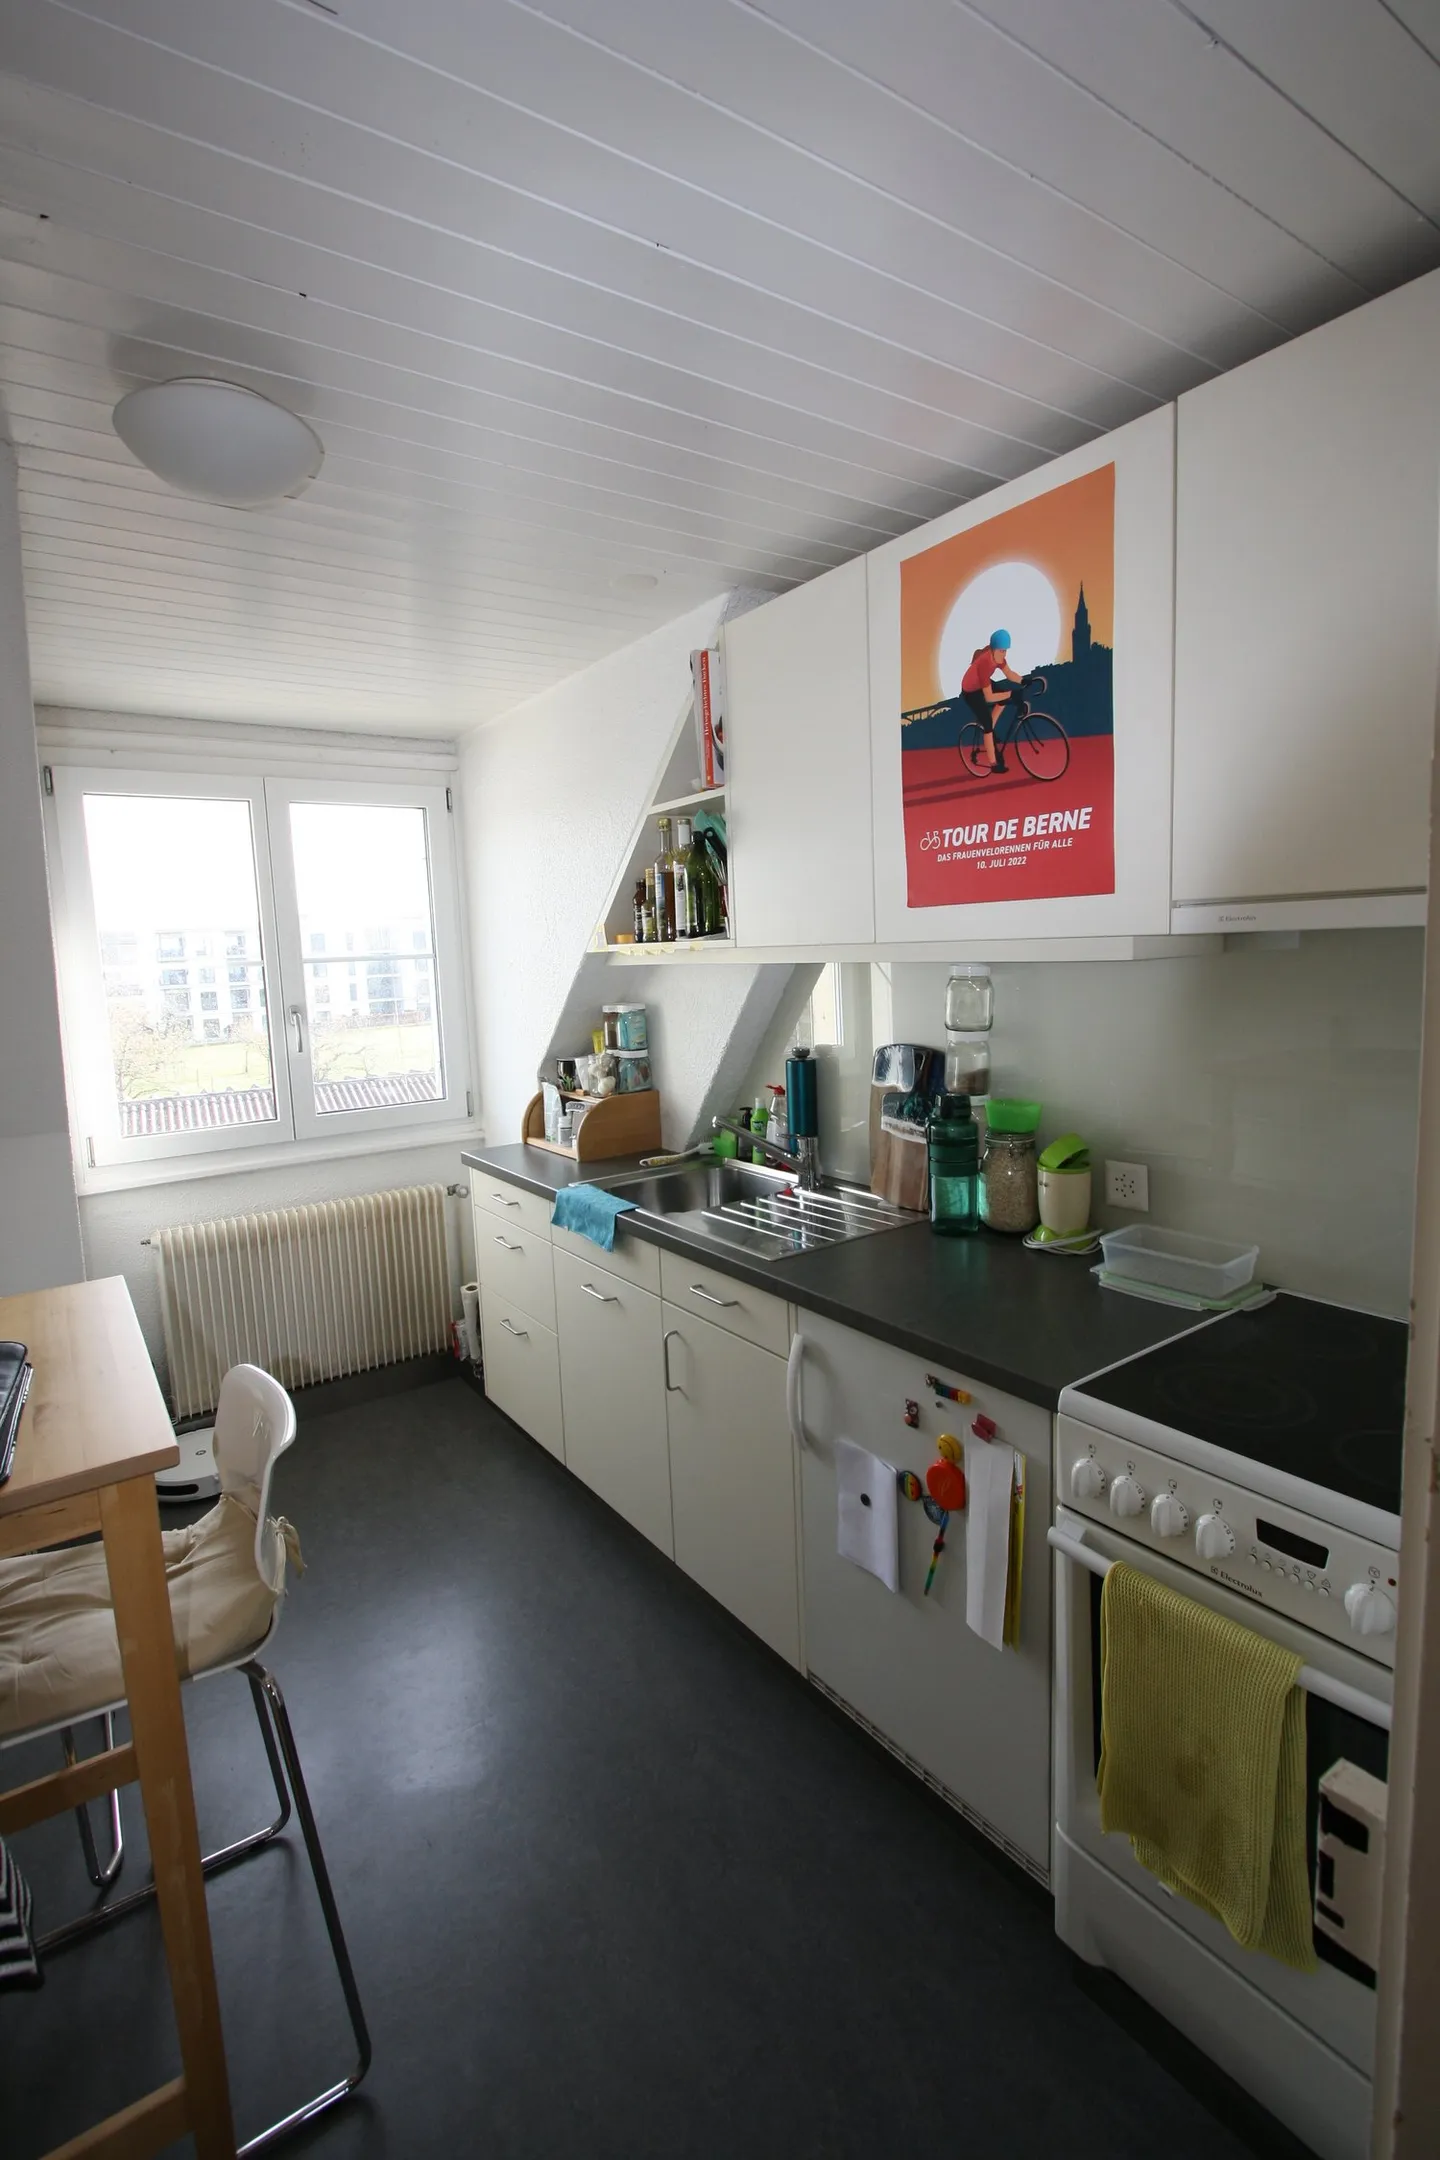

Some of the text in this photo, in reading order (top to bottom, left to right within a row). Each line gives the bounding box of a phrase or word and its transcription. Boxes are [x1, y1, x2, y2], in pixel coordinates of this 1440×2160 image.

[942, 807, 1093, 848] TOUR DE BERNE
[937, 837, 1073, 863] DAS FRAUENVELORENNEN FÜR ALLE
[976, 856, 1027, 870] 10. JULI 2022
[1220, 1570, 1263, 1598] Electrolux
